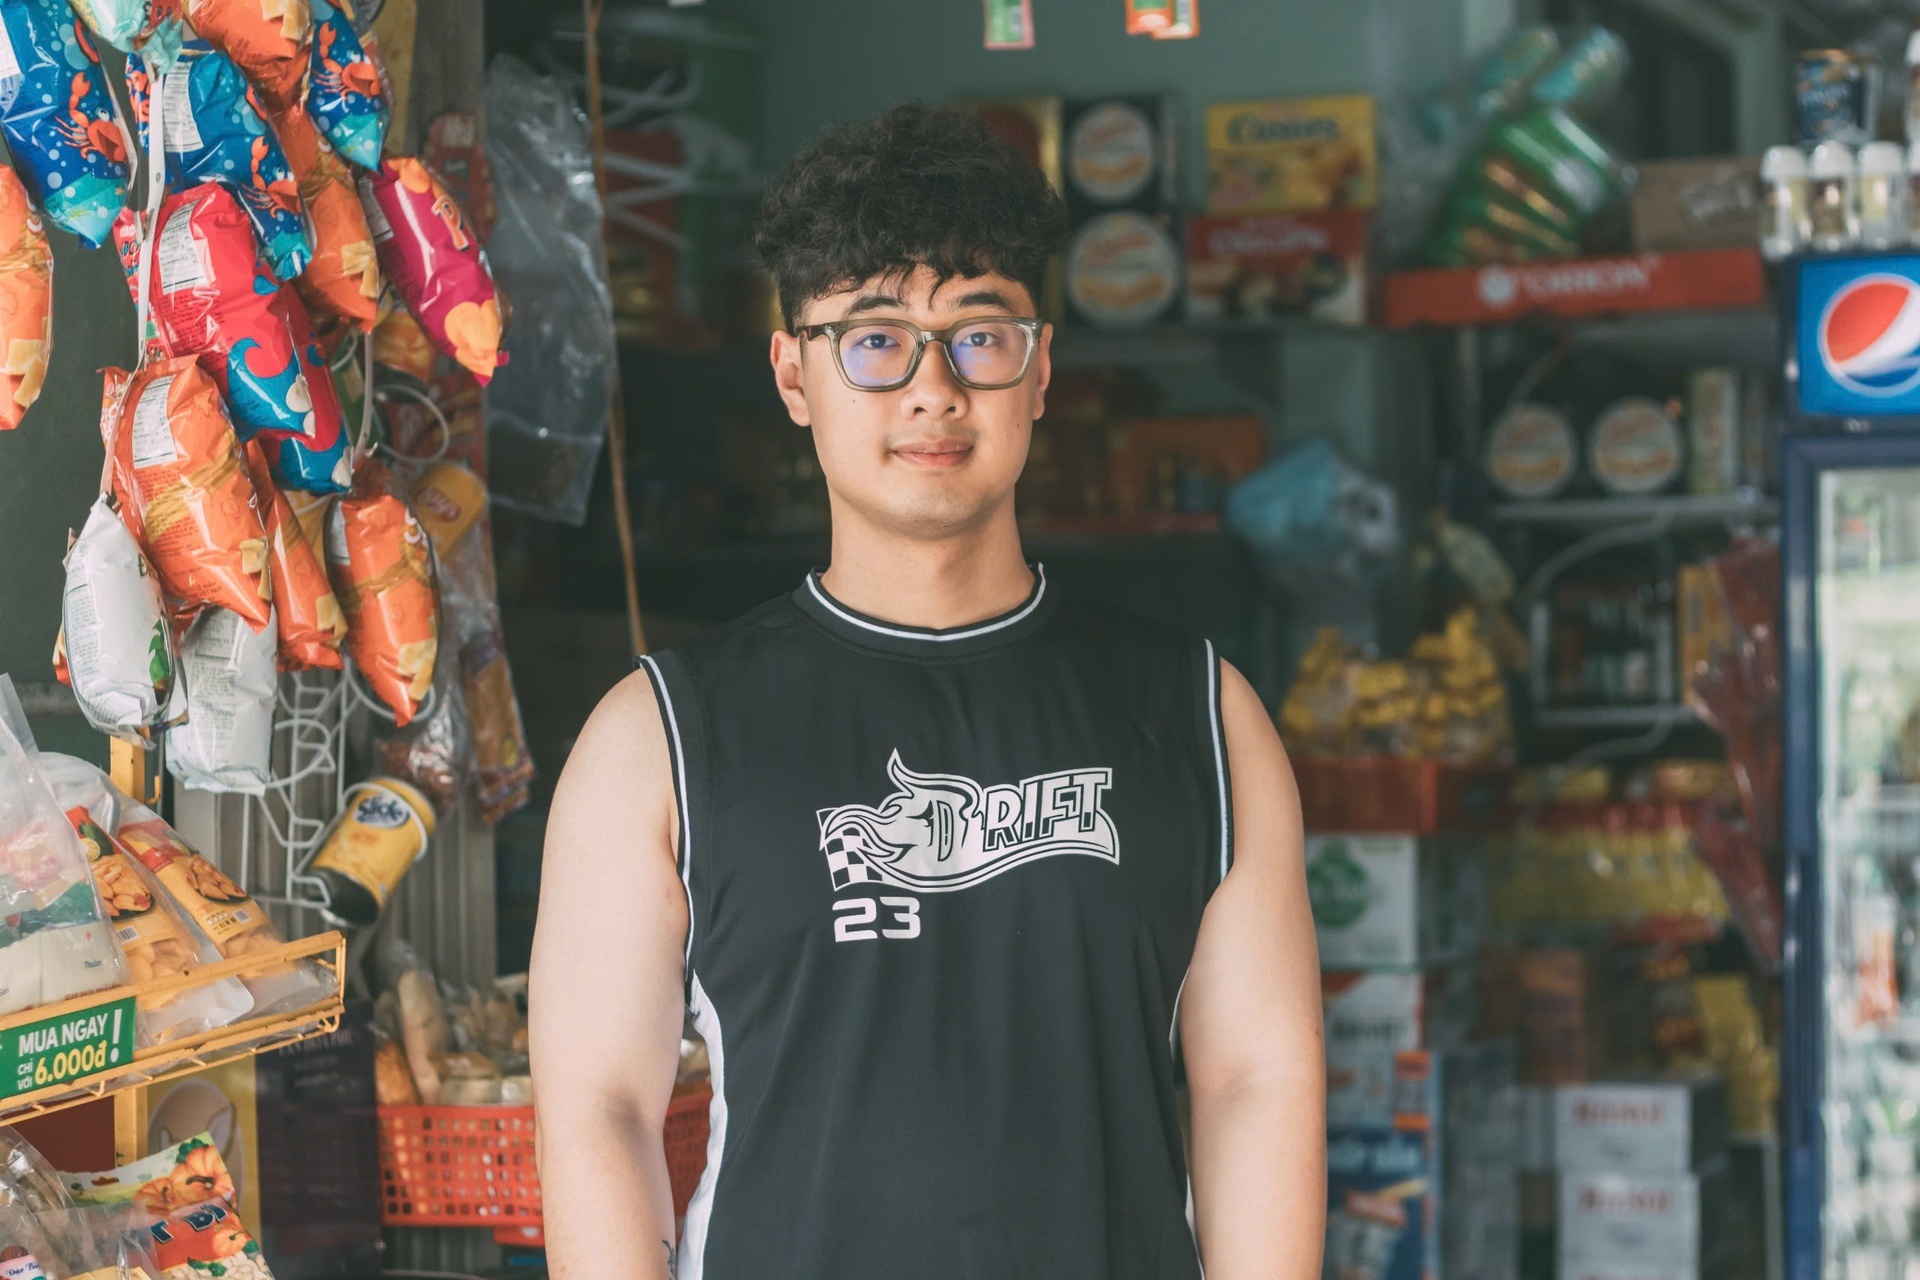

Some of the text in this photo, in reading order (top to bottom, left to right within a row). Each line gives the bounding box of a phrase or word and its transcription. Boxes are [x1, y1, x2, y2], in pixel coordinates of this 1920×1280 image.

[910, 765, 1114, 864] DRIFT
[832, 896, 921, 943] 23
[18, 1027, 59, 1058] MUA
[61, 1012, 109, 1046] NGAY
[34, 1039, 108, 1086] 6.000đ
